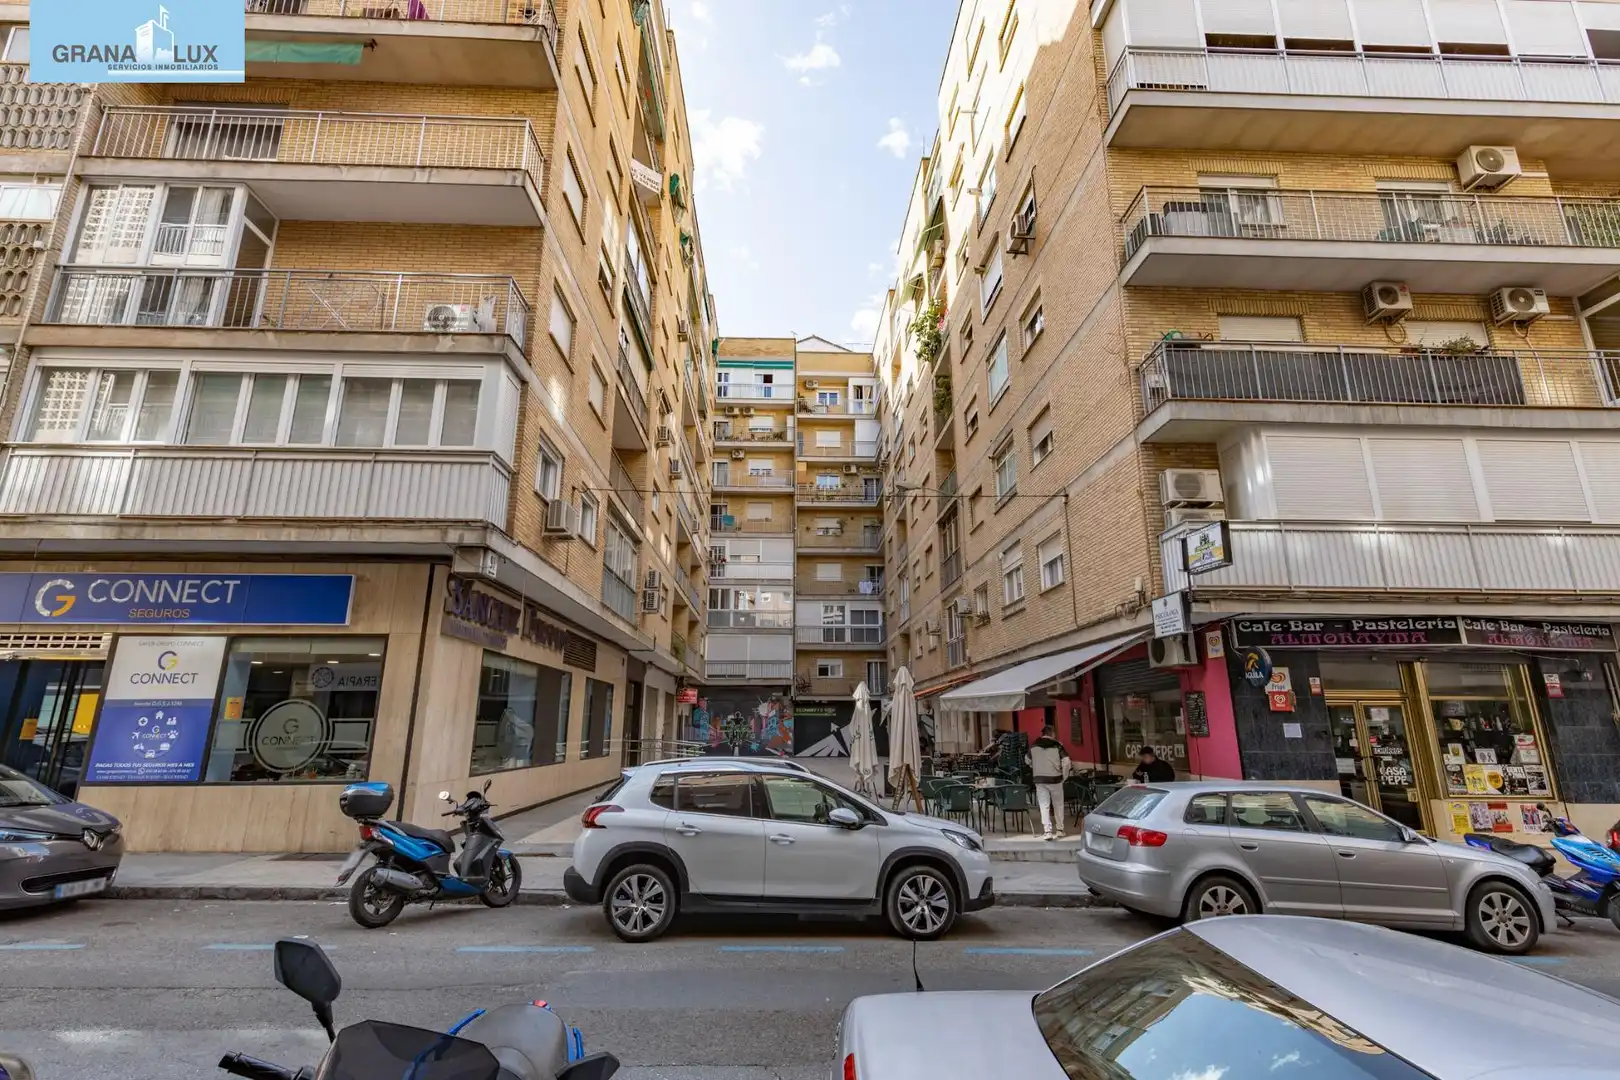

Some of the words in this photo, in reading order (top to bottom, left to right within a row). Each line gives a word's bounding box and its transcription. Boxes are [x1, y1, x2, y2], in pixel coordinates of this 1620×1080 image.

[87, 579, 241, 604] CONNECT
[128, 607, 191, 619] SEGUROS
[1352, 619, 1457, 631] Pastelería
[1271, 632, 1428, 645] ALMORAYMA
[130, 672, 199, 685] CONNECT
[1380, 766, 1407, 776] CASA
